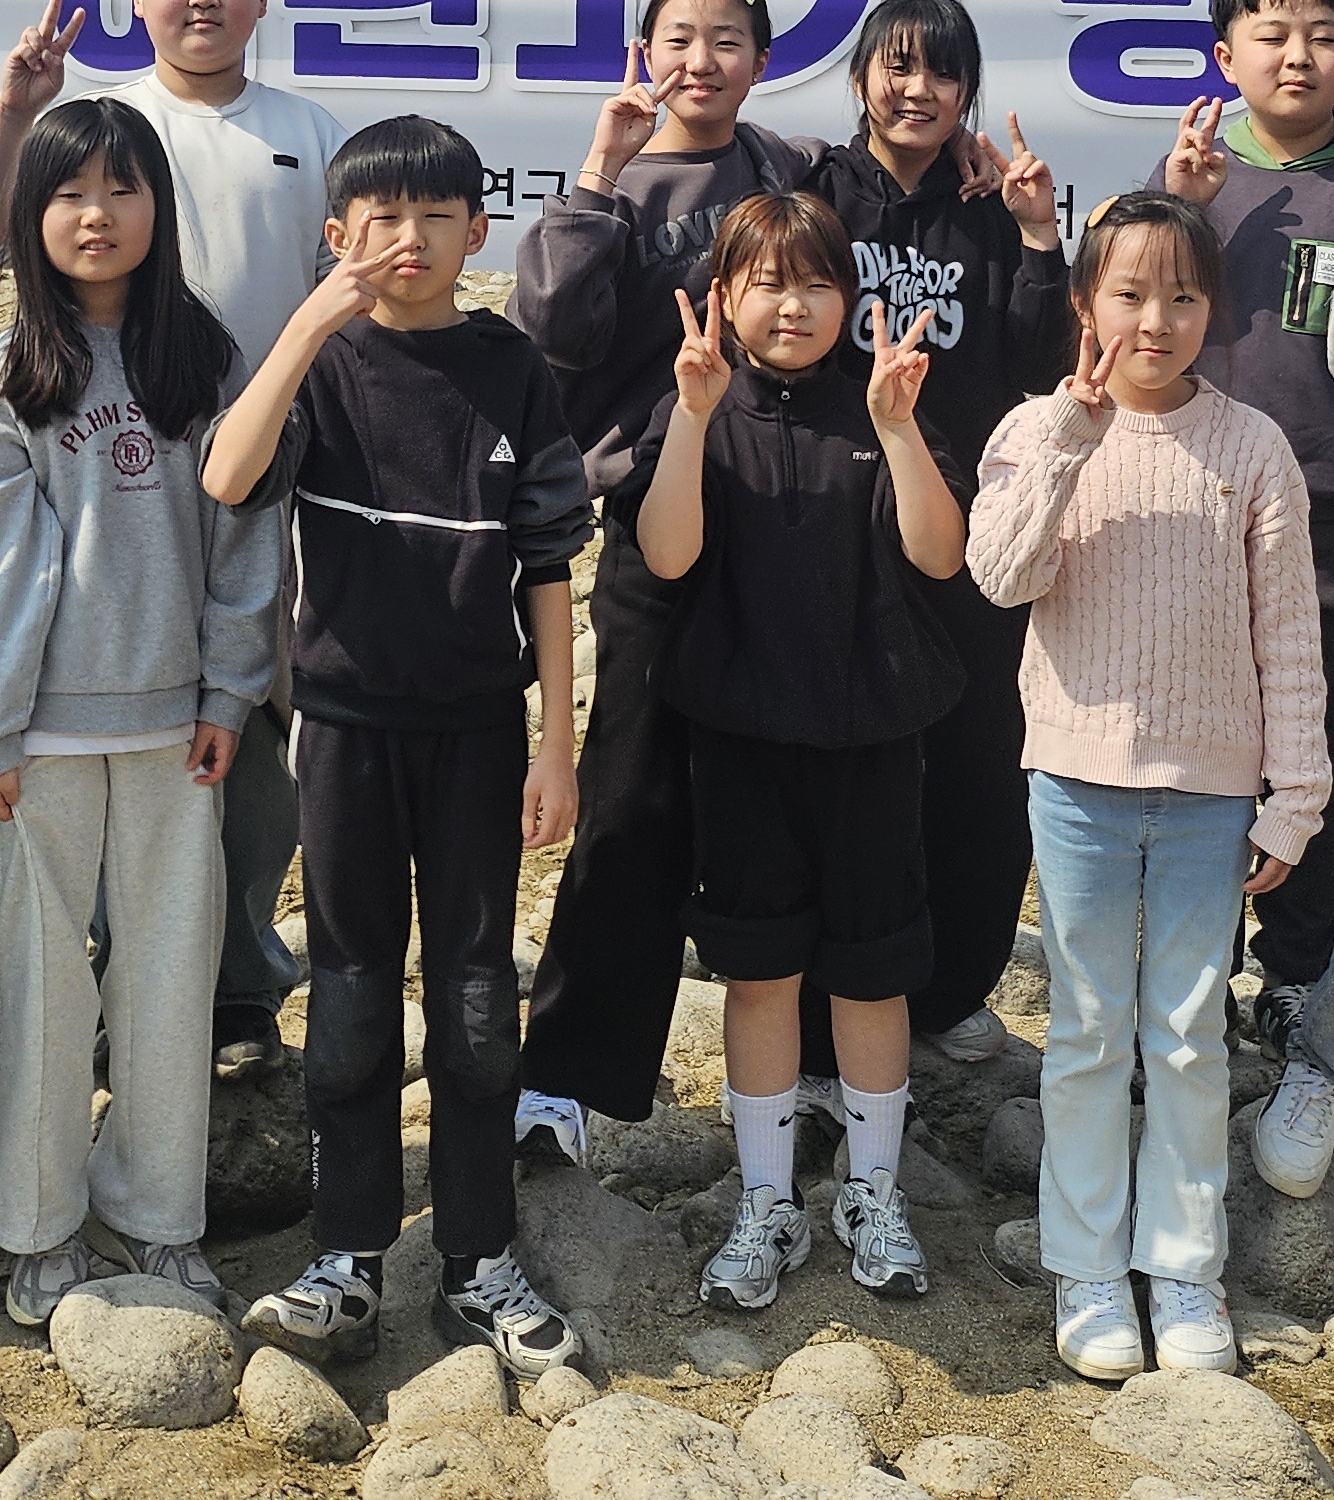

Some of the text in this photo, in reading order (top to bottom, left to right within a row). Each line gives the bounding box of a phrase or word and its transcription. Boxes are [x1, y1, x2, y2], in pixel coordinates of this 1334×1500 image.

[850, 240, 908, 291] ALL
[885, 272, 925, 307] THE
[59, 402, 121, 456] PLHM
